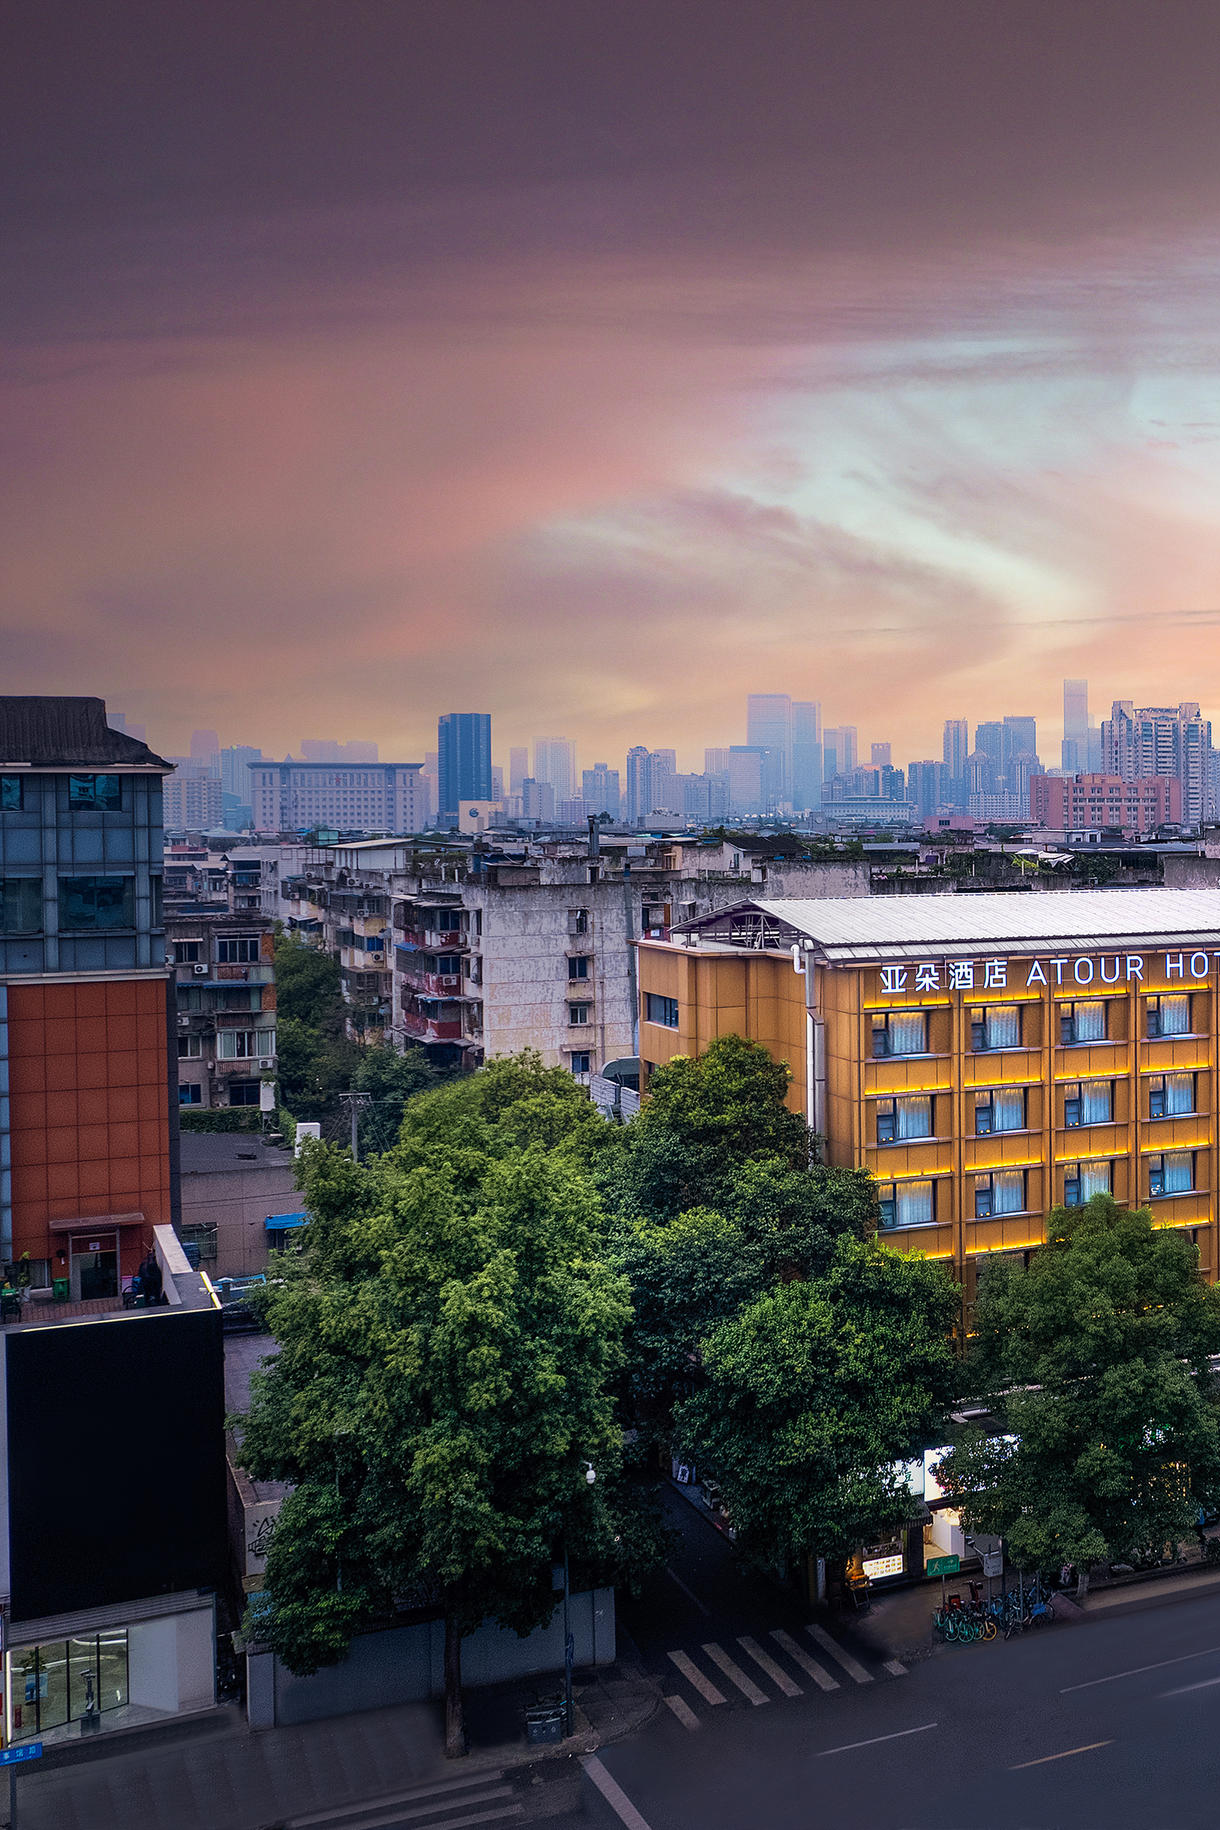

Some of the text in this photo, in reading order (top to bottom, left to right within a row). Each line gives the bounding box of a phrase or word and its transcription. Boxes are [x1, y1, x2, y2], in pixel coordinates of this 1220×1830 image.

[879, 959, 1008, 994] 亚朵酒店
[1026, 955, 1144, 987] ATOUR
